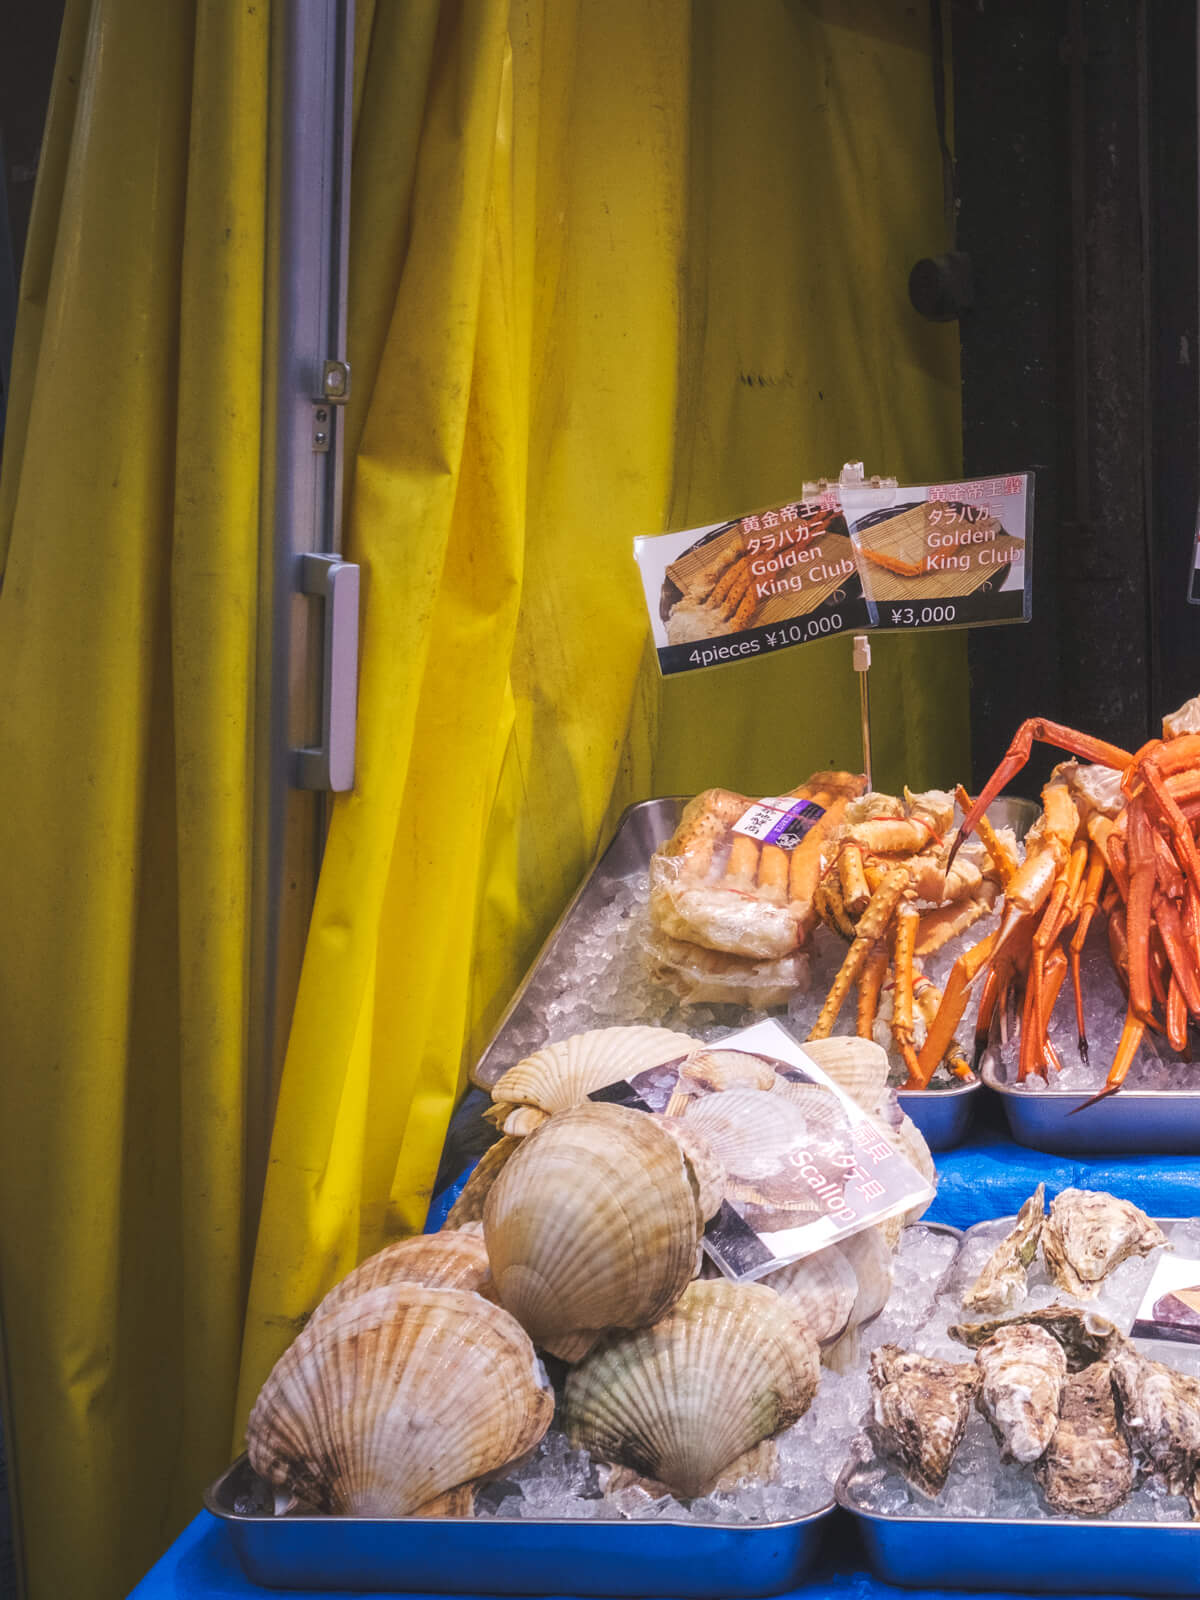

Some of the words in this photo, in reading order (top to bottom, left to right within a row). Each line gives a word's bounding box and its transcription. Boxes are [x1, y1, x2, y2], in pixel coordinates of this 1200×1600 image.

[928, 476, 1023, 503] 黄金帝王蟹
[741, 492, 842, 535] 黄金帝王蟹
[928, 503, 1008, 527] タラバガニ
[747, 520, 826, 555] タラバガニ
[927, 528, 996, 548] Golden
[751, 546, 823, 576] Golden
[926, 555, 971, 571] King
[978, 546, 1022, 565] Club
[756, 575, 802, 598] King
[809, 559, 854, 583] Club
[891, 605, 956, 627] ¥3,000
[689, 638, 761, 666] 4pieces
[765, 613, 843, 647] ¥10,000
[789, 1150, 857, 1221] Scallop
